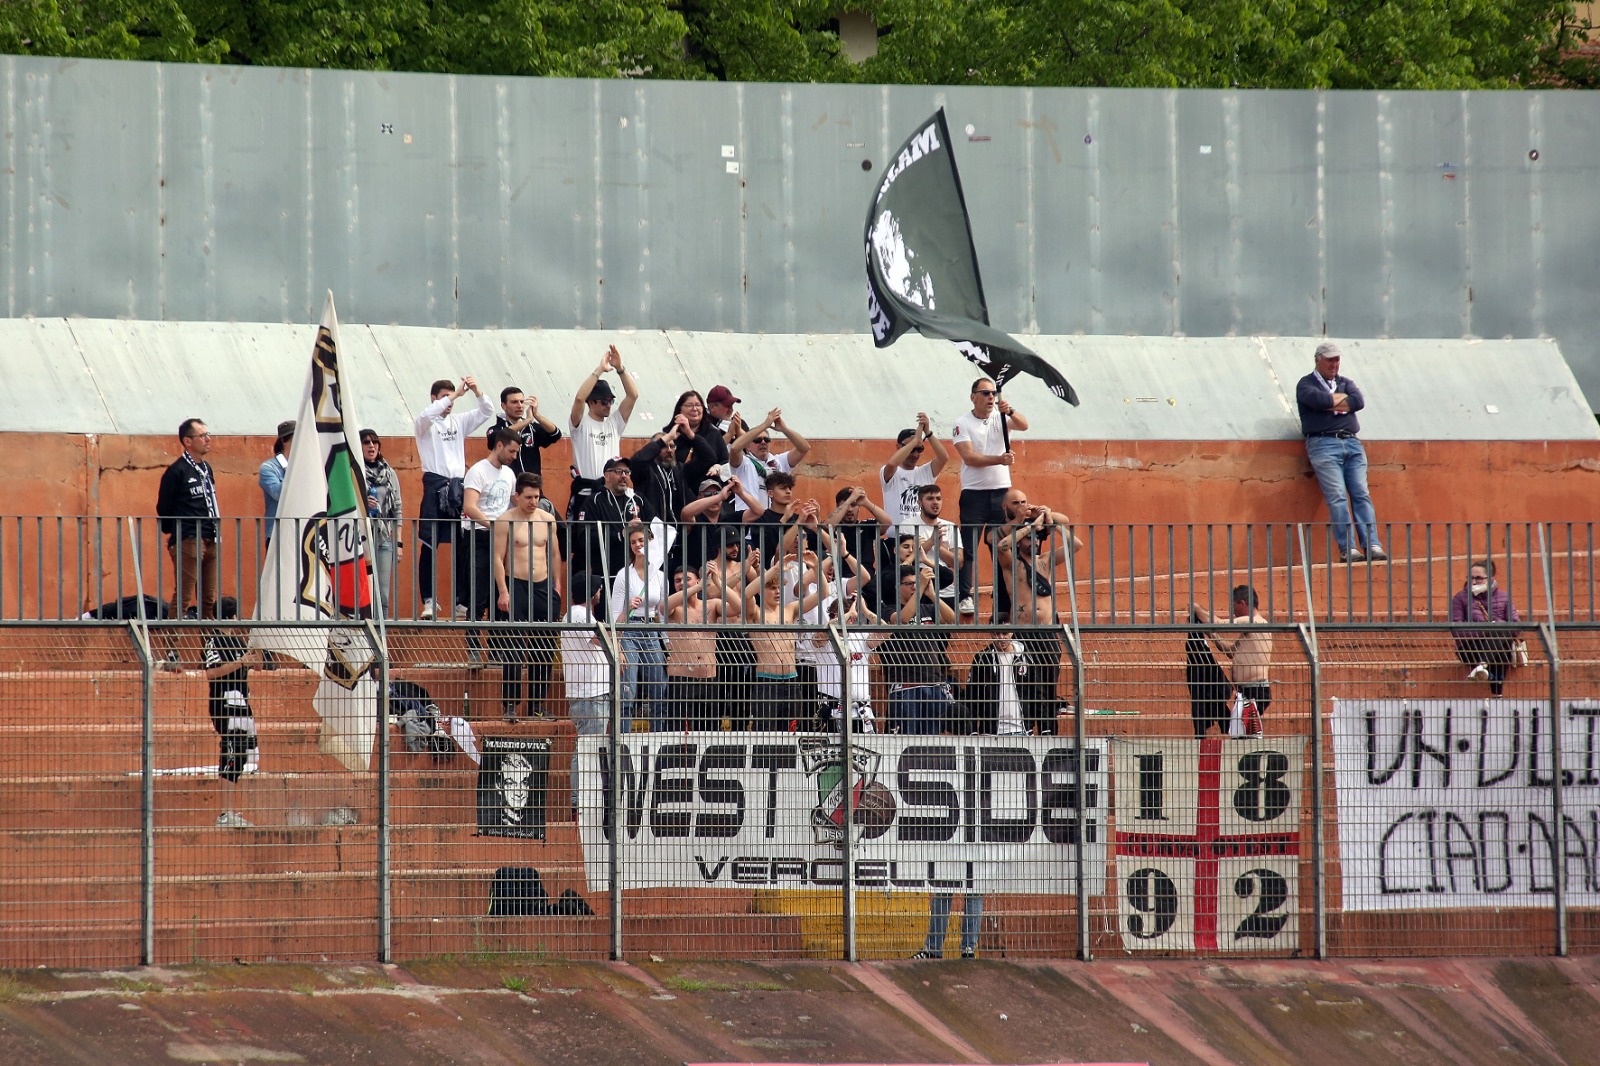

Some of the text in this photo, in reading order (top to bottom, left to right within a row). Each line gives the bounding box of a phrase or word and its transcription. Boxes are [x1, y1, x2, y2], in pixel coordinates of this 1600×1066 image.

[485, 740, 547, 750] MASSIMO VIVE
[598, 743, 1099, 844] WEST SIDE
[1211, 834, 1290, 855] OVEST
[694, 856, 972, 889] VERCELLI
